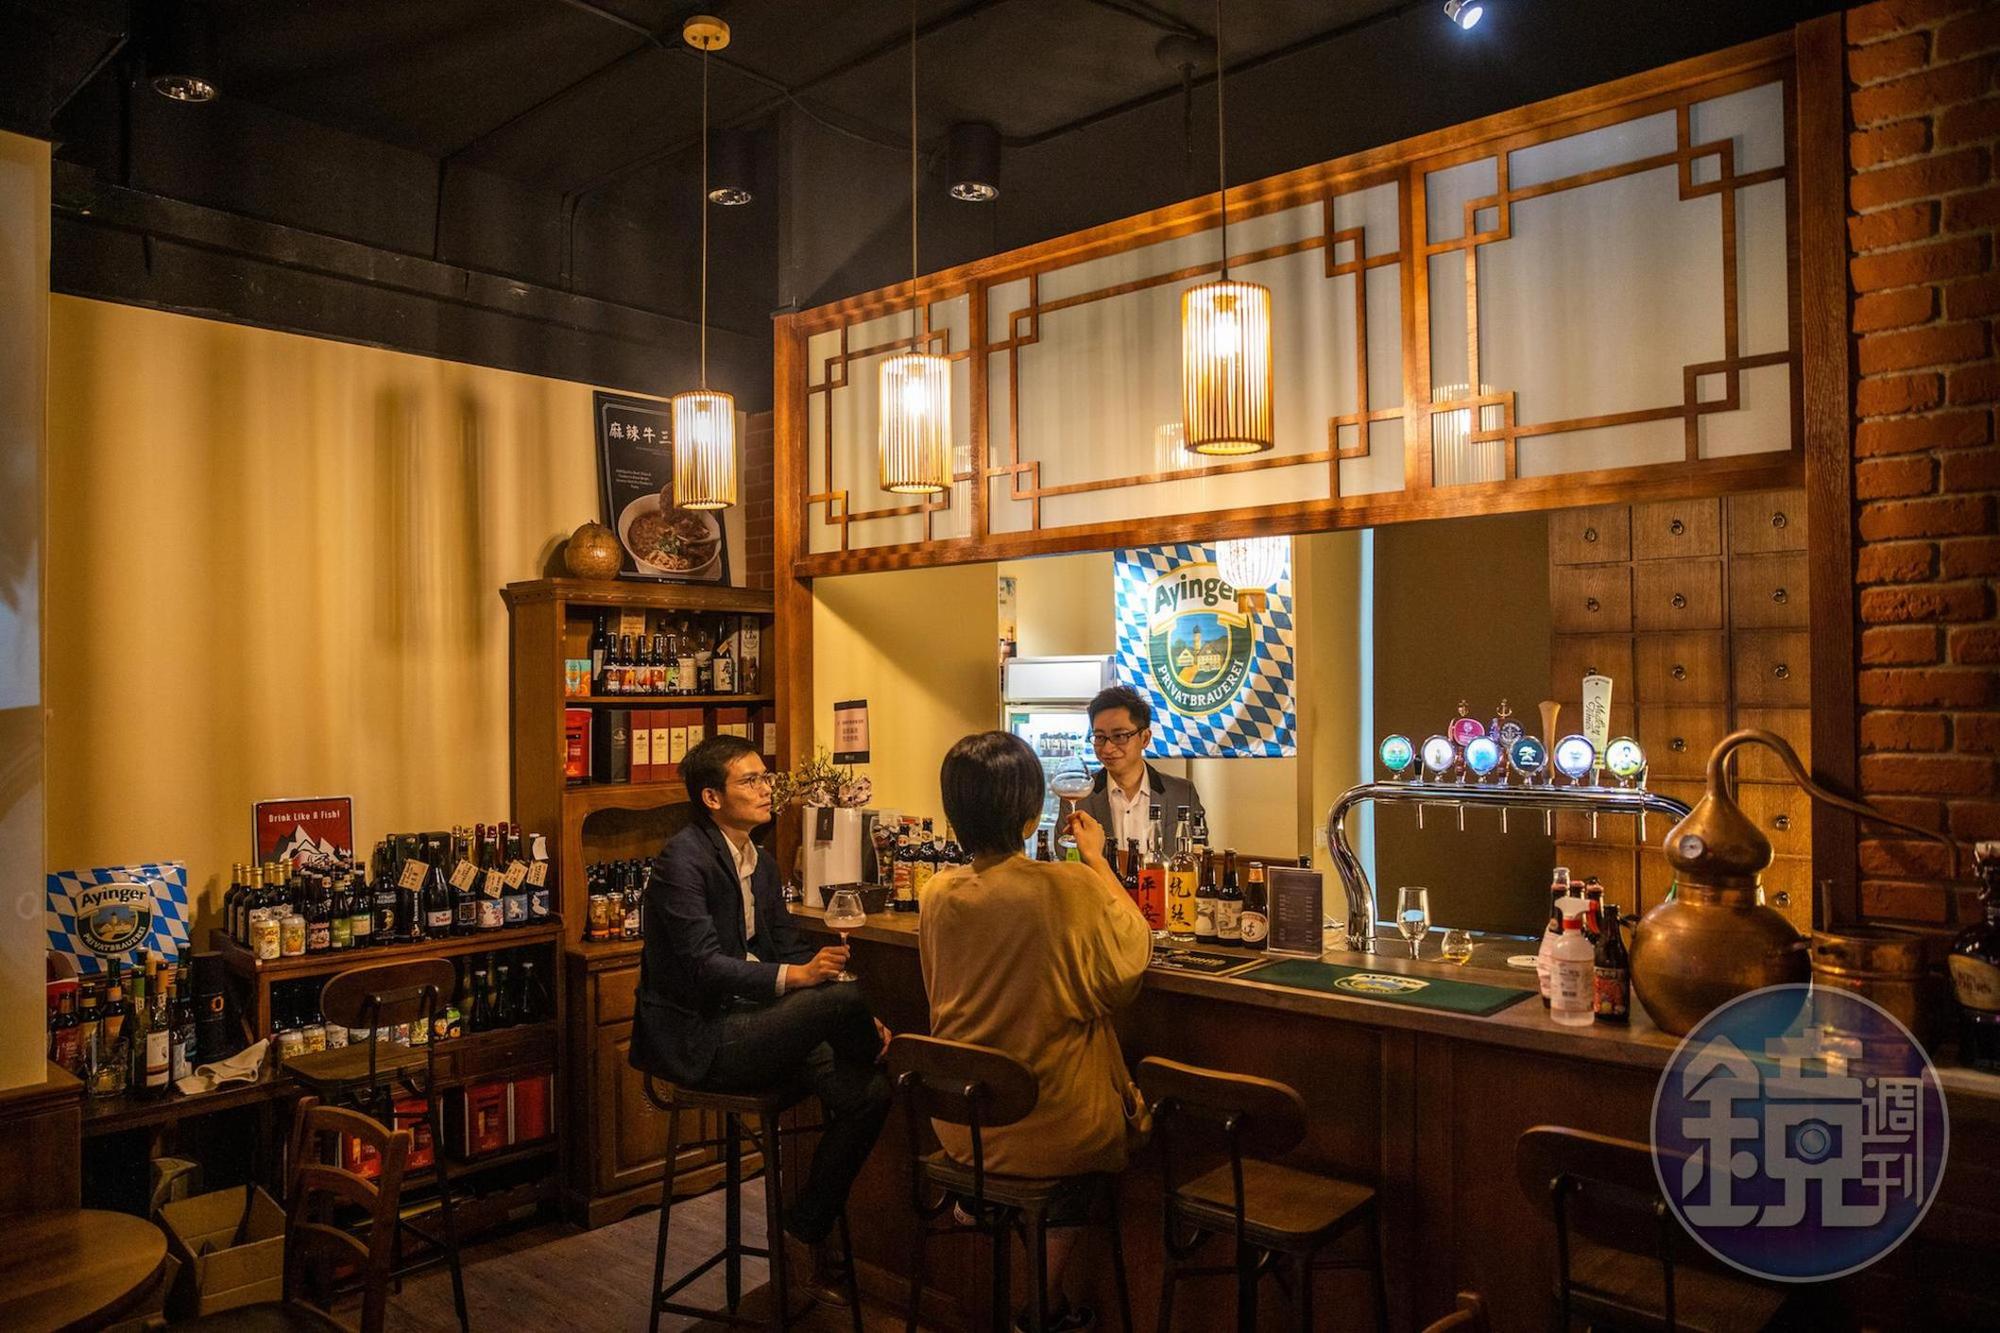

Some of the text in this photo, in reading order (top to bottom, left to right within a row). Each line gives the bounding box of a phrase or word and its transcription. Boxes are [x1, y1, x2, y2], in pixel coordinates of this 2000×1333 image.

[608, 421, 672, 445] 麻辣牛三
[1158, 659, 1245, 706] PRIVATBRAUEREI
[268, 813, 292, 823] Drink
[293, 812, 311, 821] Like
[320, 809, 340, 819] Fish!
[81, 886, 147, 907] Ayinger
[82, 926, 147, 952] PRIVATBRAUEREI
